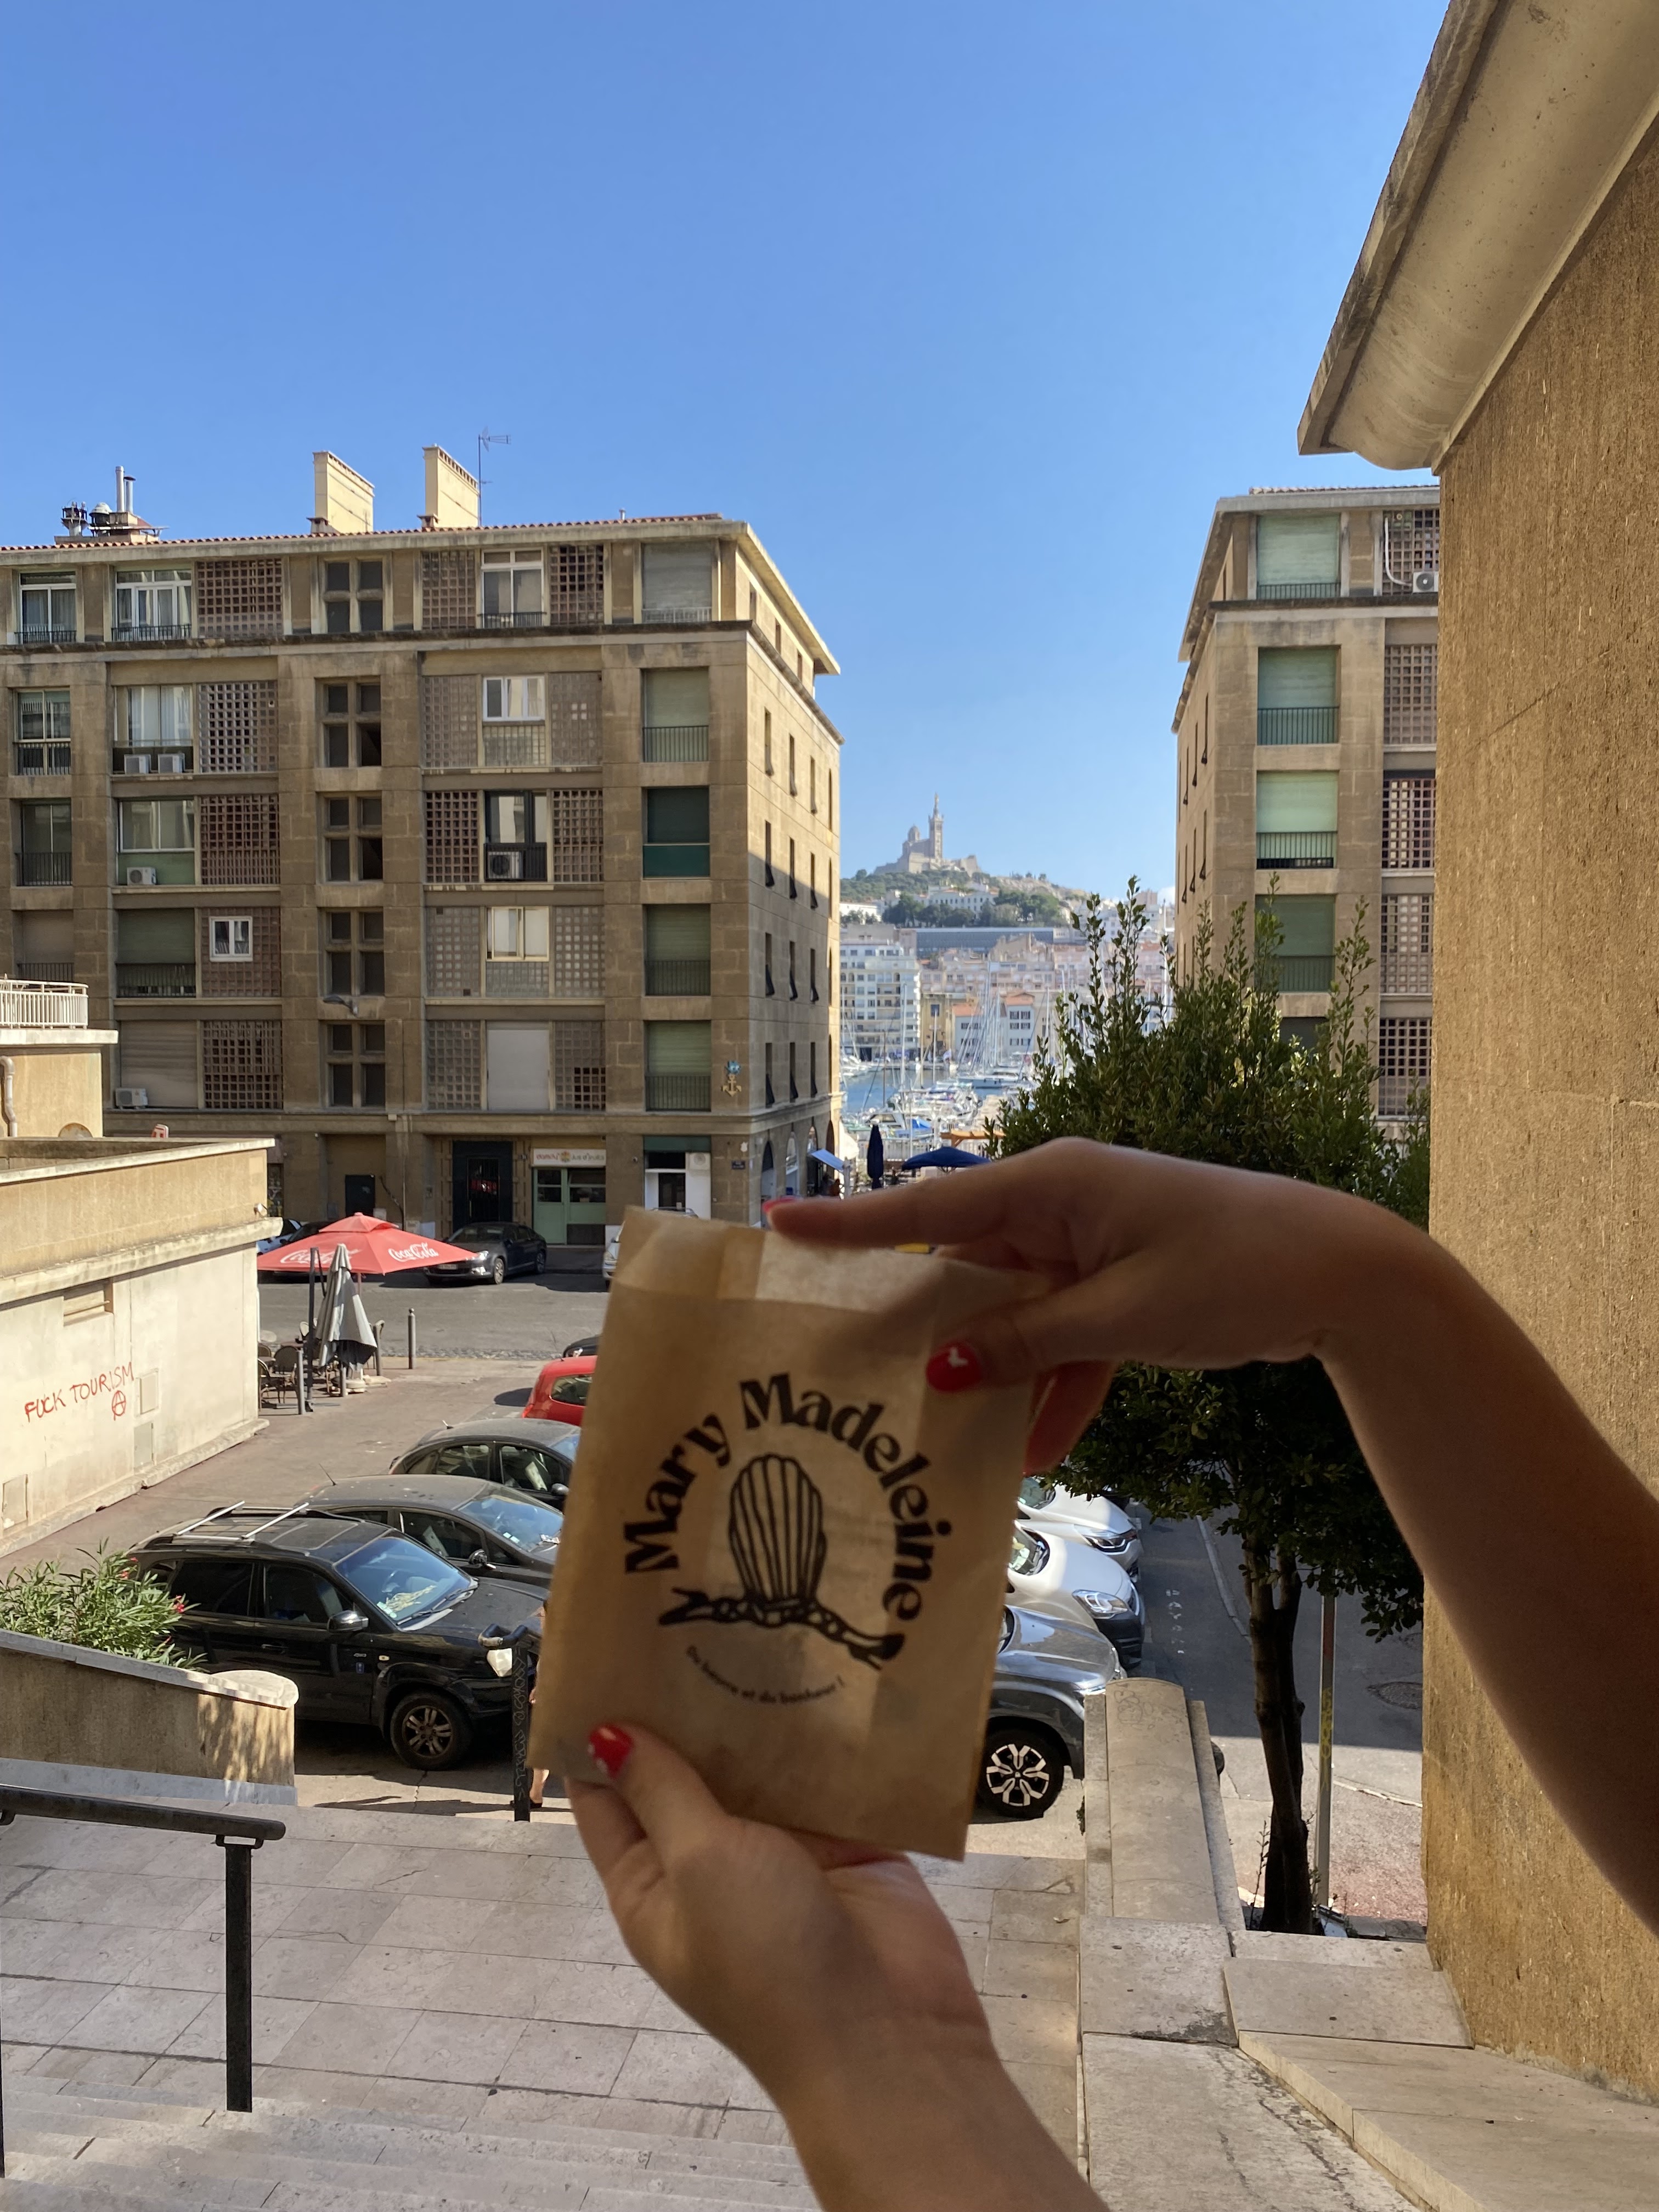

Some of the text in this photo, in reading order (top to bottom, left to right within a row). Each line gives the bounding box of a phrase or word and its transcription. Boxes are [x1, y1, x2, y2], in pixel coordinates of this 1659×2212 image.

[388, 1242, 439, 1262] Coca-Cola
[25, 1362, 134, 1423] FUCK TOURISM
[624, 1373, 953, 1621] Mary Madeleine
